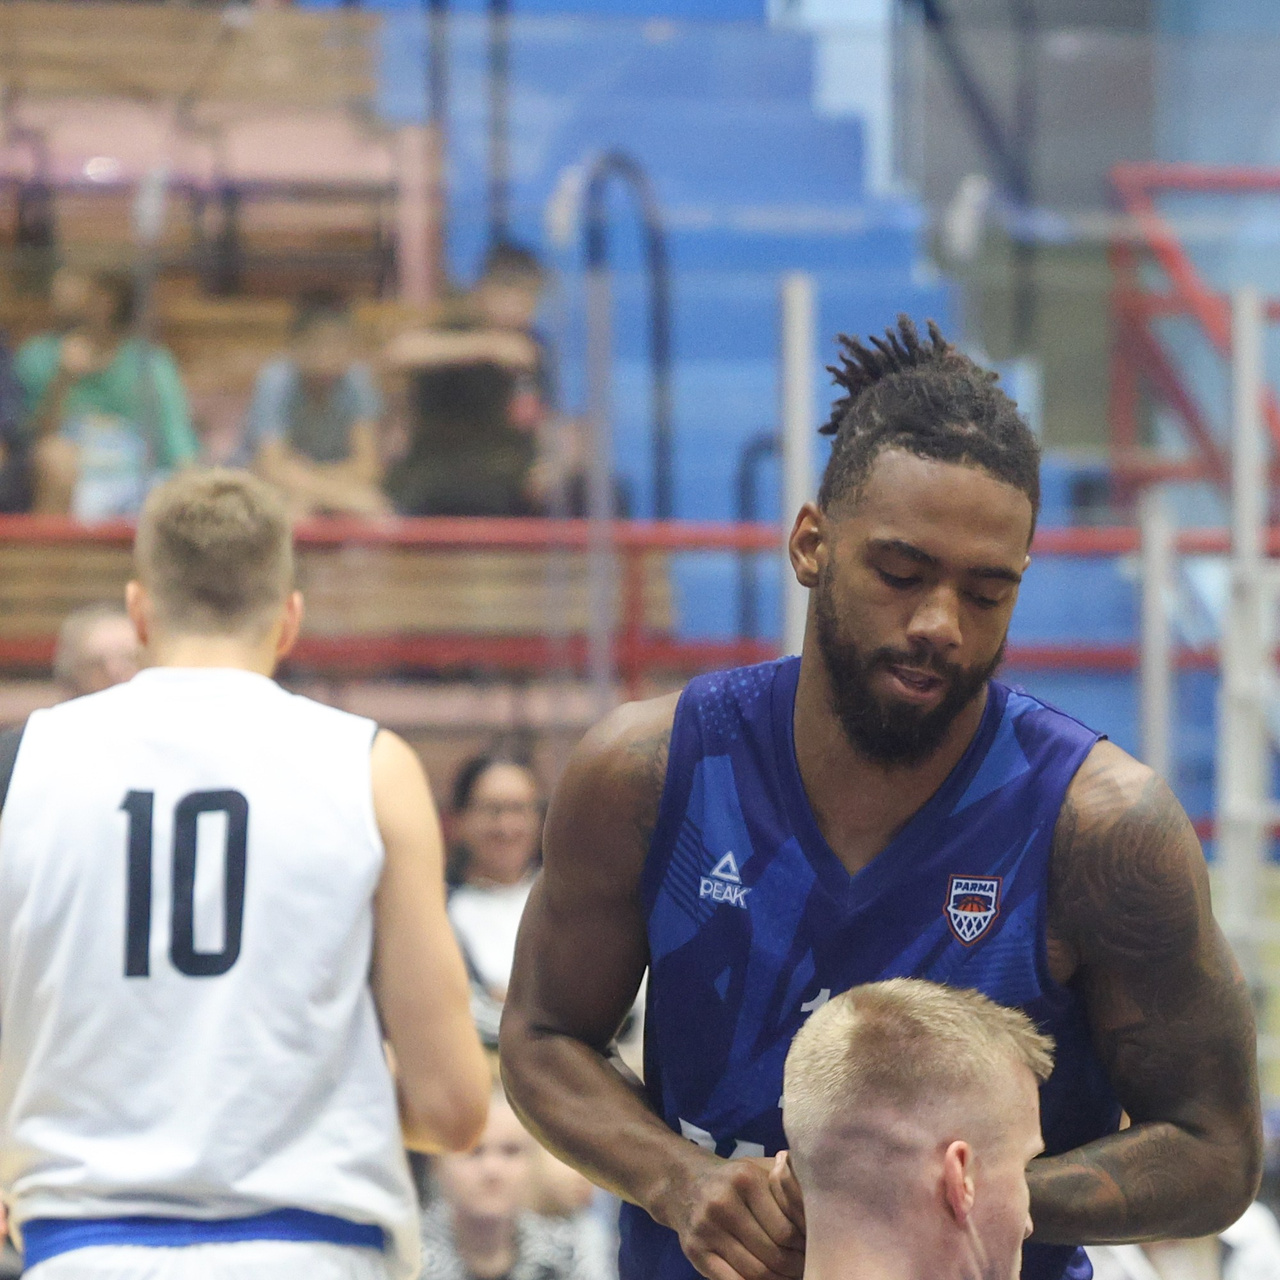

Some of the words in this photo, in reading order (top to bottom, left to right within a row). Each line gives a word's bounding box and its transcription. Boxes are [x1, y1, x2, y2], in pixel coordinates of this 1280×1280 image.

[119, 789, 249, 977] 10
[699, 876, 752, 909] PEAK
[954, 881, 994, 893] PARMA
